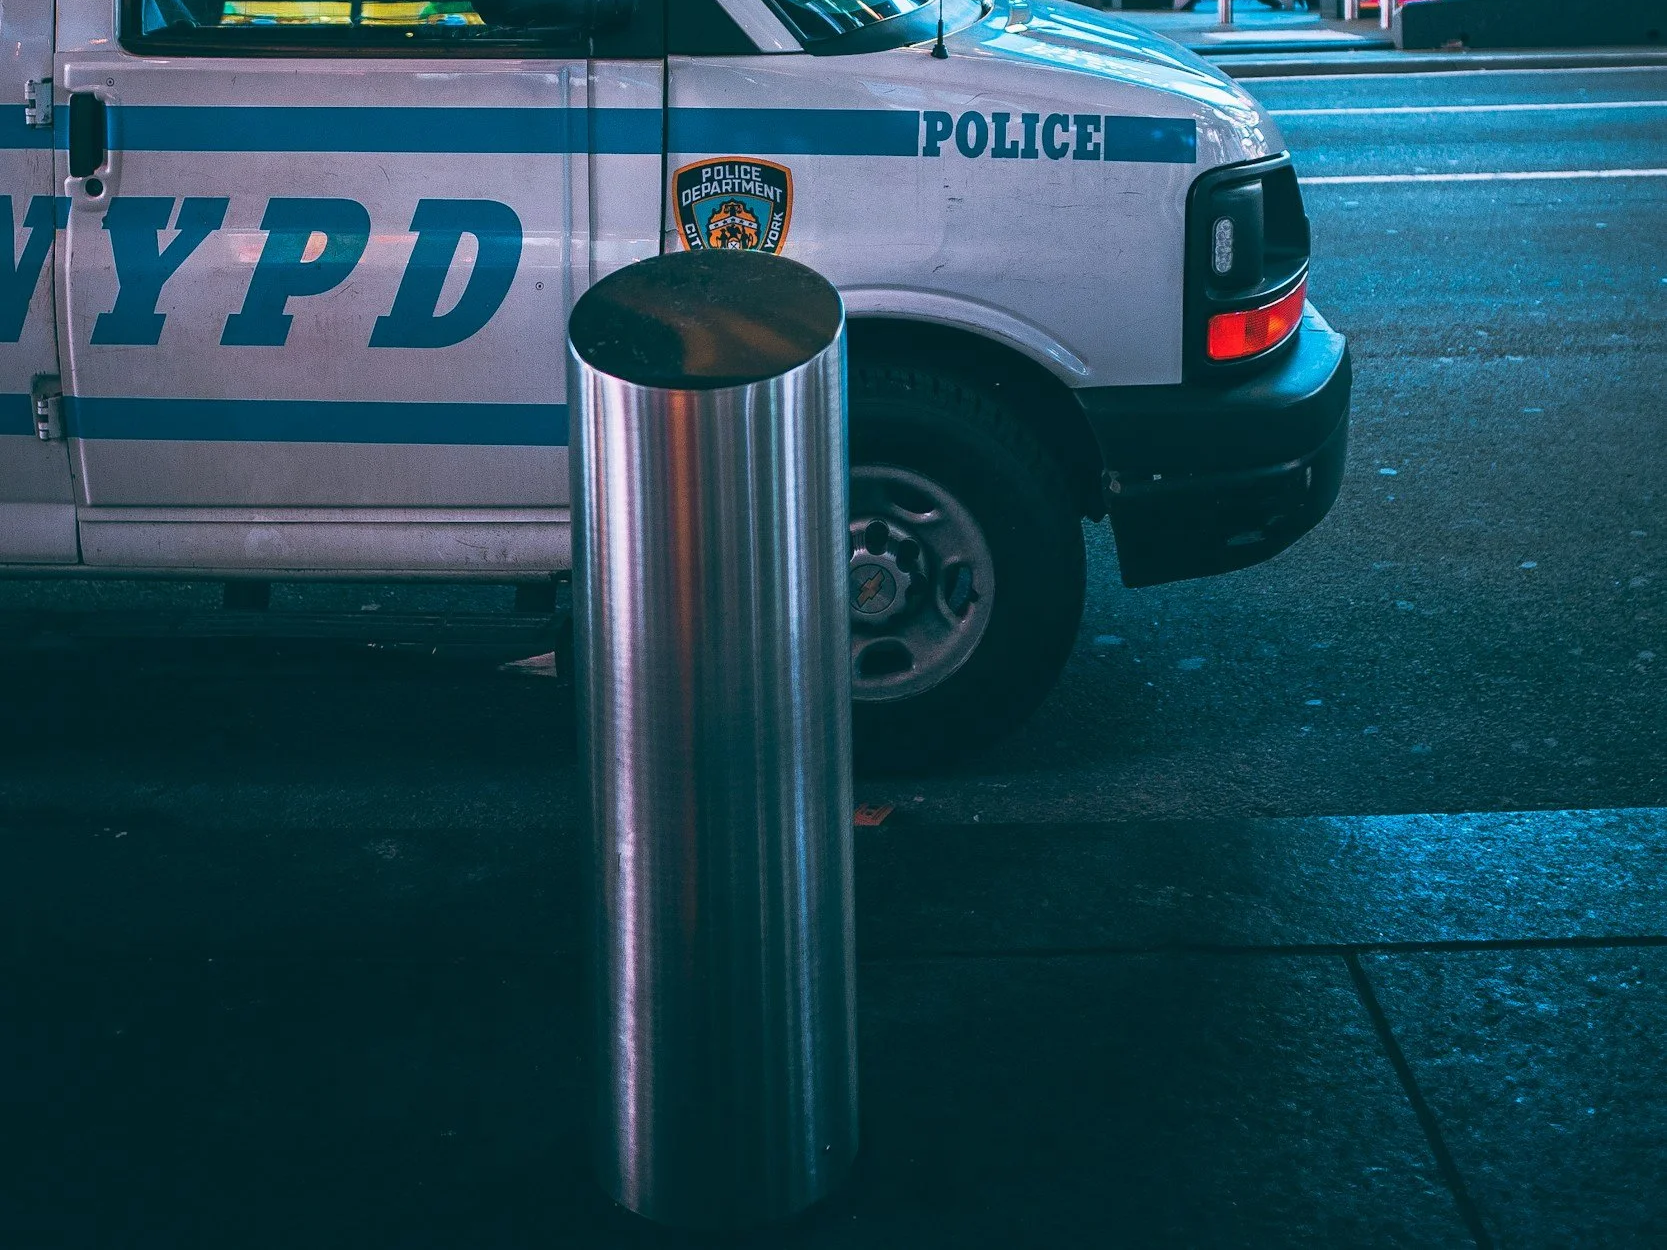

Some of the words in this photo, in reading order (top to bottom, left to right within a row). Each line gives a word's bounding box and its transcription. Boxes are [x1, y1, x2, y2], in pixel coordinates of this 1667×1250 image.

[922, 110, 1102, 161] POLICE
[702, 165, 762, 183] POLICE
[682, 179, 783, 207] DEPARTMENT
[685, 223, 704, 250] CIT
[763, 211, 784, 248] YORK
